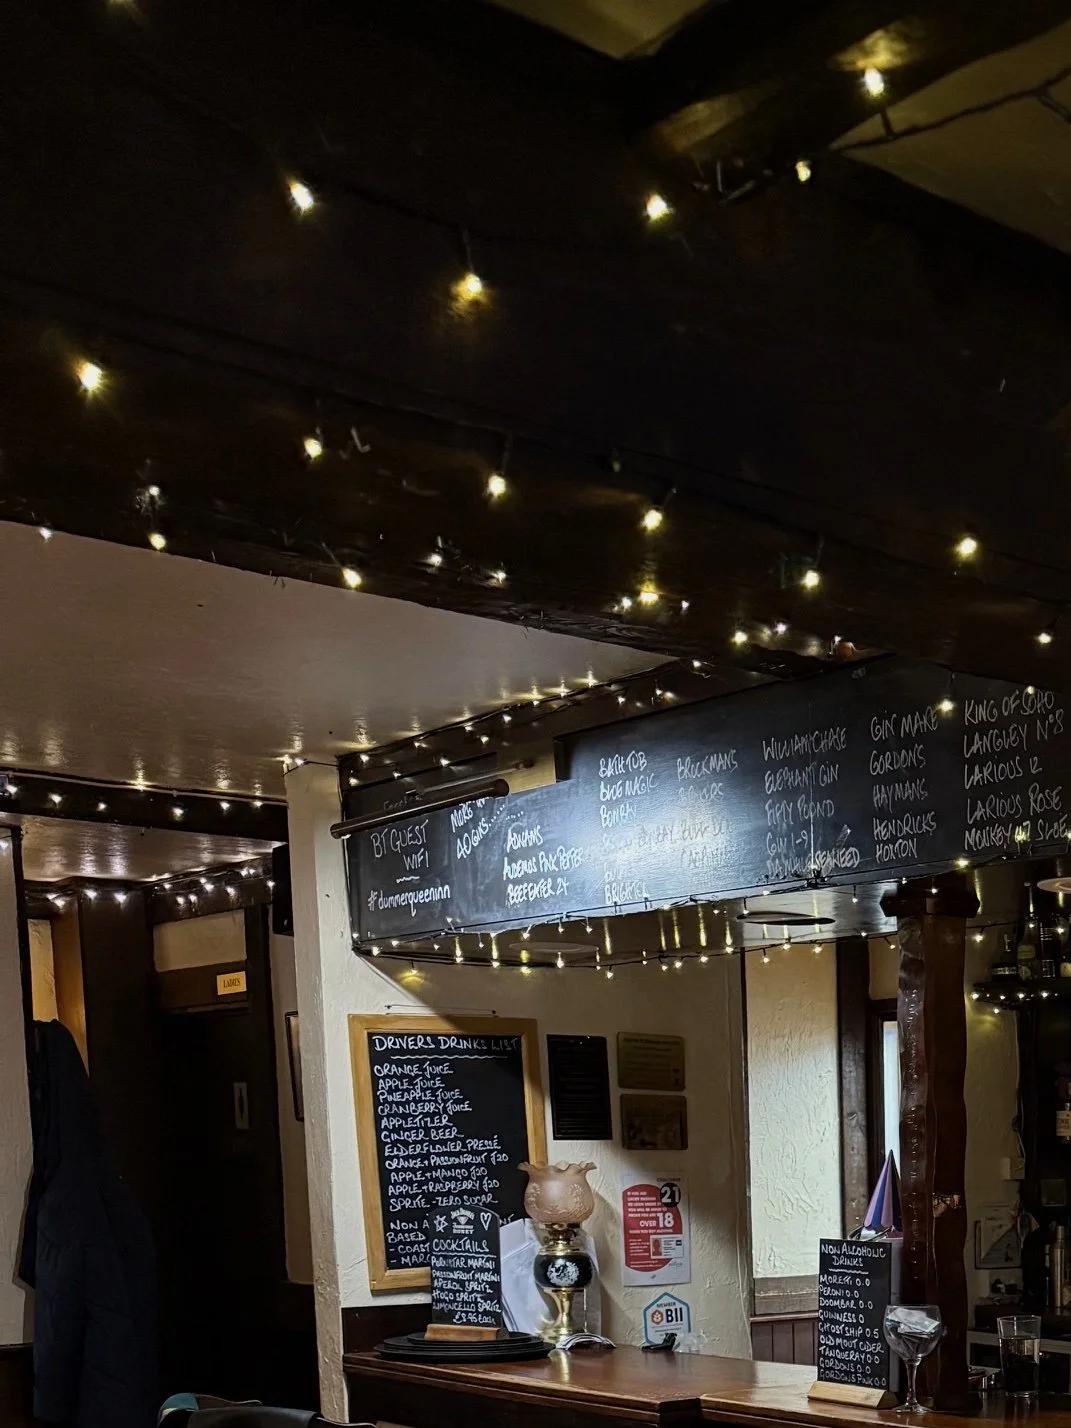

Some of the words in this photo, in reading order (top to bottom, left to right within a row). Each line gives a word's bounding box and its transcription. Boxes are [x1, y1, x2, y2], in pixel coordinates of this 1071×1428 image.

[964, 699, 998, 726] KING
[1001, 689, 1021, 717] OF
[870, 710, 898, 741] GIN
[900, 705, 938, 738] MARE
[762, 733, 812, 761] WILLIAM
[811, 727, 847, 752] CHASE
[963, 723, 1028, 758] LANGLEY
[598, 754, 626, 779] BATH
[676, 749, 739, 782] BROCKMANS
[964, 756, 1024, 790] LARIOUS
[624, 772, 658, 796] MAGIC
[764, 761, 817, 795] ELEPHANT
[818, 761, 839, 787] GIN
[872, 777, 929, 814] HAYMANS
[967, 792, 1023, 825] LARIOUS
[1028, 782, 1063, 816] ROSE
[764, 798, 794, 827] FIFTY
[797, 793, 835, 822] POUND
[389, 819, 429, 854] GUEST
[964, 822, 1013, 851] MONKEY
[1035, 813, 1069, 841] SLOE
[766, 831, 787, 857] GIN
[875, 837, 918, 864] HOXTON
[402, 847, 430, 871] WIFI
[506, 878, 555, 905] BEEFEATER
[556, 876, 570, 896] 24
[372, 1035, 436, 1052] DRIVERS
[437, 1036, 488, 1051] DRINKS
[491, 1038, 520, 1051] LIST
[373, 1062, 423, 1077] ORANGE
[422, 1061, 454, 1078] JUICE
[378, 1078, 413, 1091] APPLE
[413, 1076, 446, 1094] JUICE
[377, 1090, 436, 1103] PINEAPPLE
[435, 1088, 464, 1103] JUICE
[377, 1102, 446, 1116] CRANBERRY
[446, 1100, 473, 1115] JUICE
[380, 1114, 454, 1130] APPLETIZER
[380, 1129, 430, 1143] GINGER
[430, 1126, 465, 1140] BEER
[384, 1141, 467, 1157] ELDERFLOWER
[490, 1150, 509, 1166] J20
[469, 1165, 488, 1180] J20
[482, 1176, 500, 1192] J20
[389, 1195, 431, 1212] SPRITE
[462, 1192, 499, 1207] SUGAR
[660, 1185, 680, 1203] 21
[389, 1219, 419, 1231] NON
[657, 1212, 675, 1228] 18
[385, 1231, 427, 1244] BASED
[432, 1236, 490, 1253] COCKTAILS
[821, 1243, 841, 1254] NON
[841, 1242, 887, 1258] ALCOHOLIC
[831, 1255, 864, 1267] DRINKS
[433, 1279, 463, 1291] APEROL
[464, 1281, 493, 1294] SPRITZ
[819, 1273, 853, 1286] MORETTI
[855, 1277, 871, 1287] 0.0
[432, 1290, 454, 1303] HUGO
[819, 1284, 845, 1297] PERONI
[477, 1299, 502, 1313] SPRITZ
[819, 1297, 857, 1309] DOOMBAR
[858, 1300, 874, 1310] 0.0
[665, 1307, 683, 1323] BII
[818, 1309, 857, 1323] GUINNESS
[818, 1321, 844, 1334] GHOST
[844, 1325, 864, 1338] SHIP
[819, 1334, 836, 1346] OLD
[858, 1340, 885, 1354] CIDER
[818, 1345, 866, 1364] TANQUERAY
